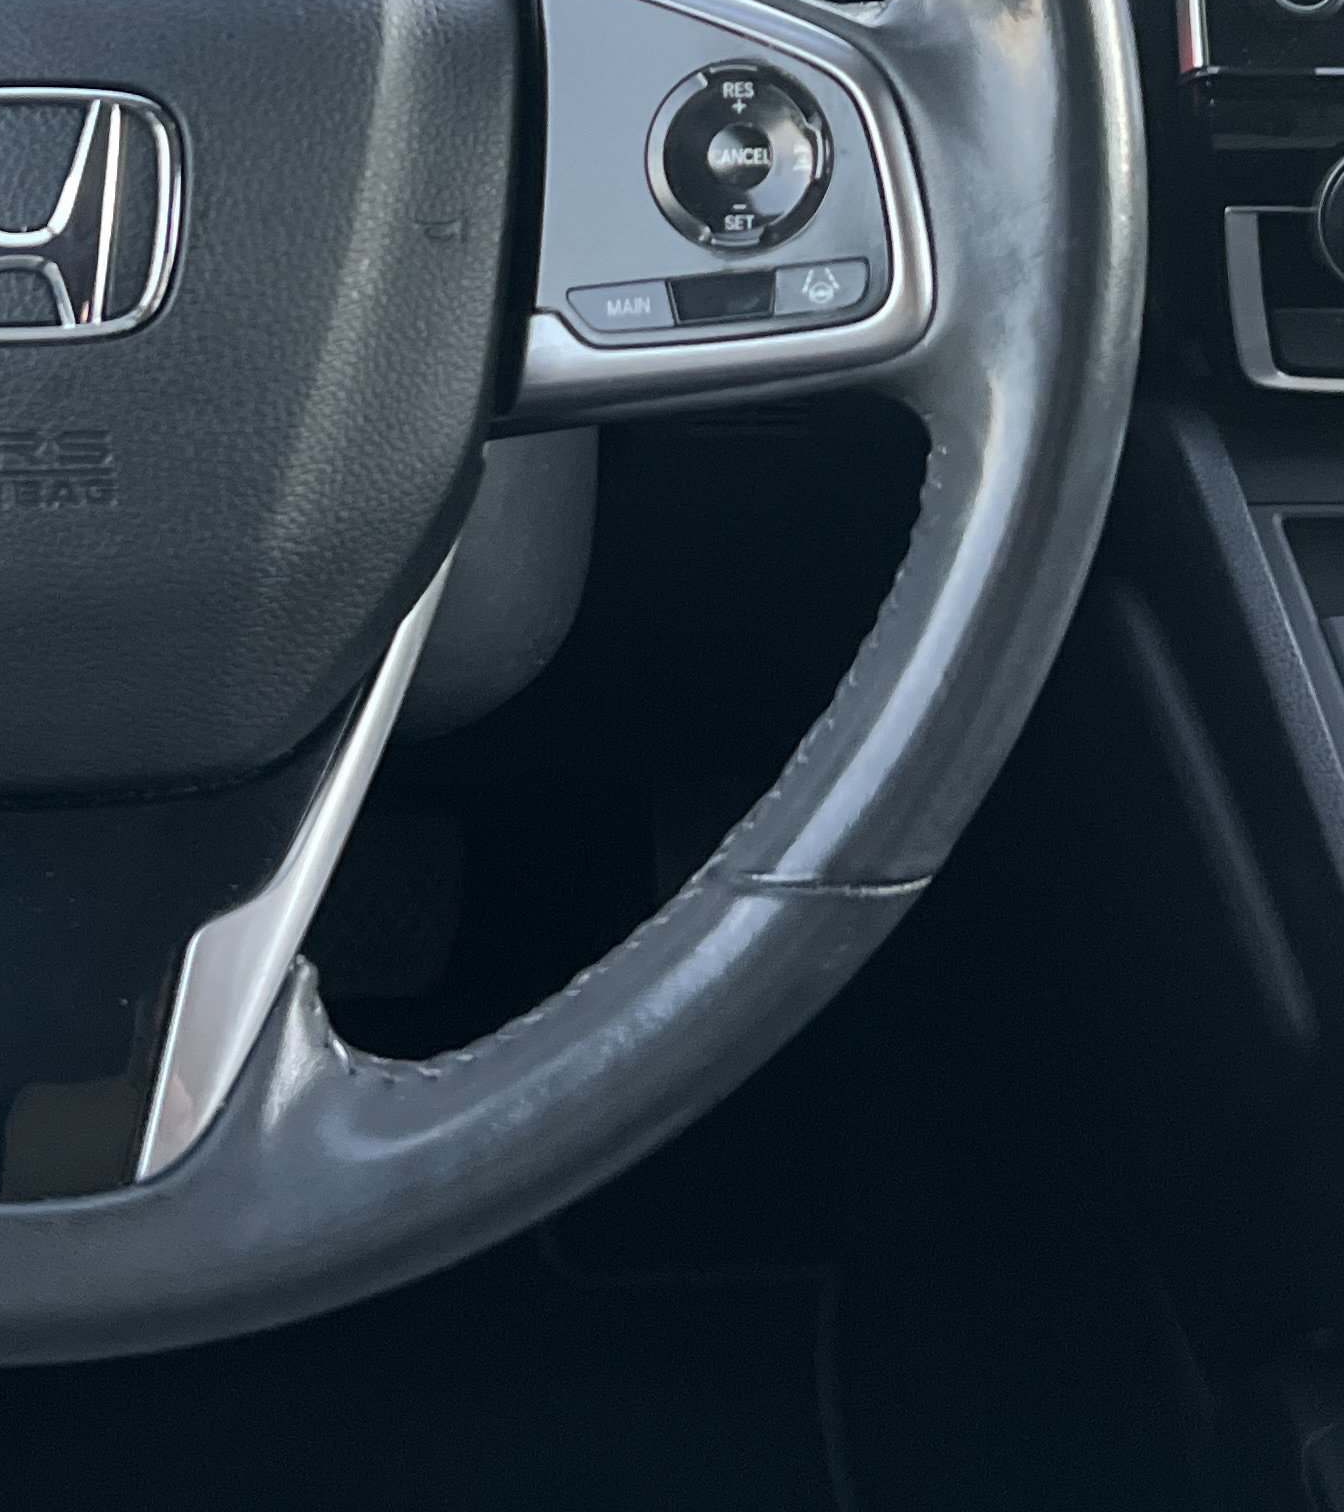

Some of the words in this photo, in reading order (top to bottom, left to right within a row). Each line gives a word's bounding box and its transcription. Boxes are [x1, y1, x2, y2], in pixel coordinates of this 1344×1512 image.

[722, 81, 755, 99] RES
[724, 214, 755, 231] SET
[607, 297, 651, 316] MAIN
